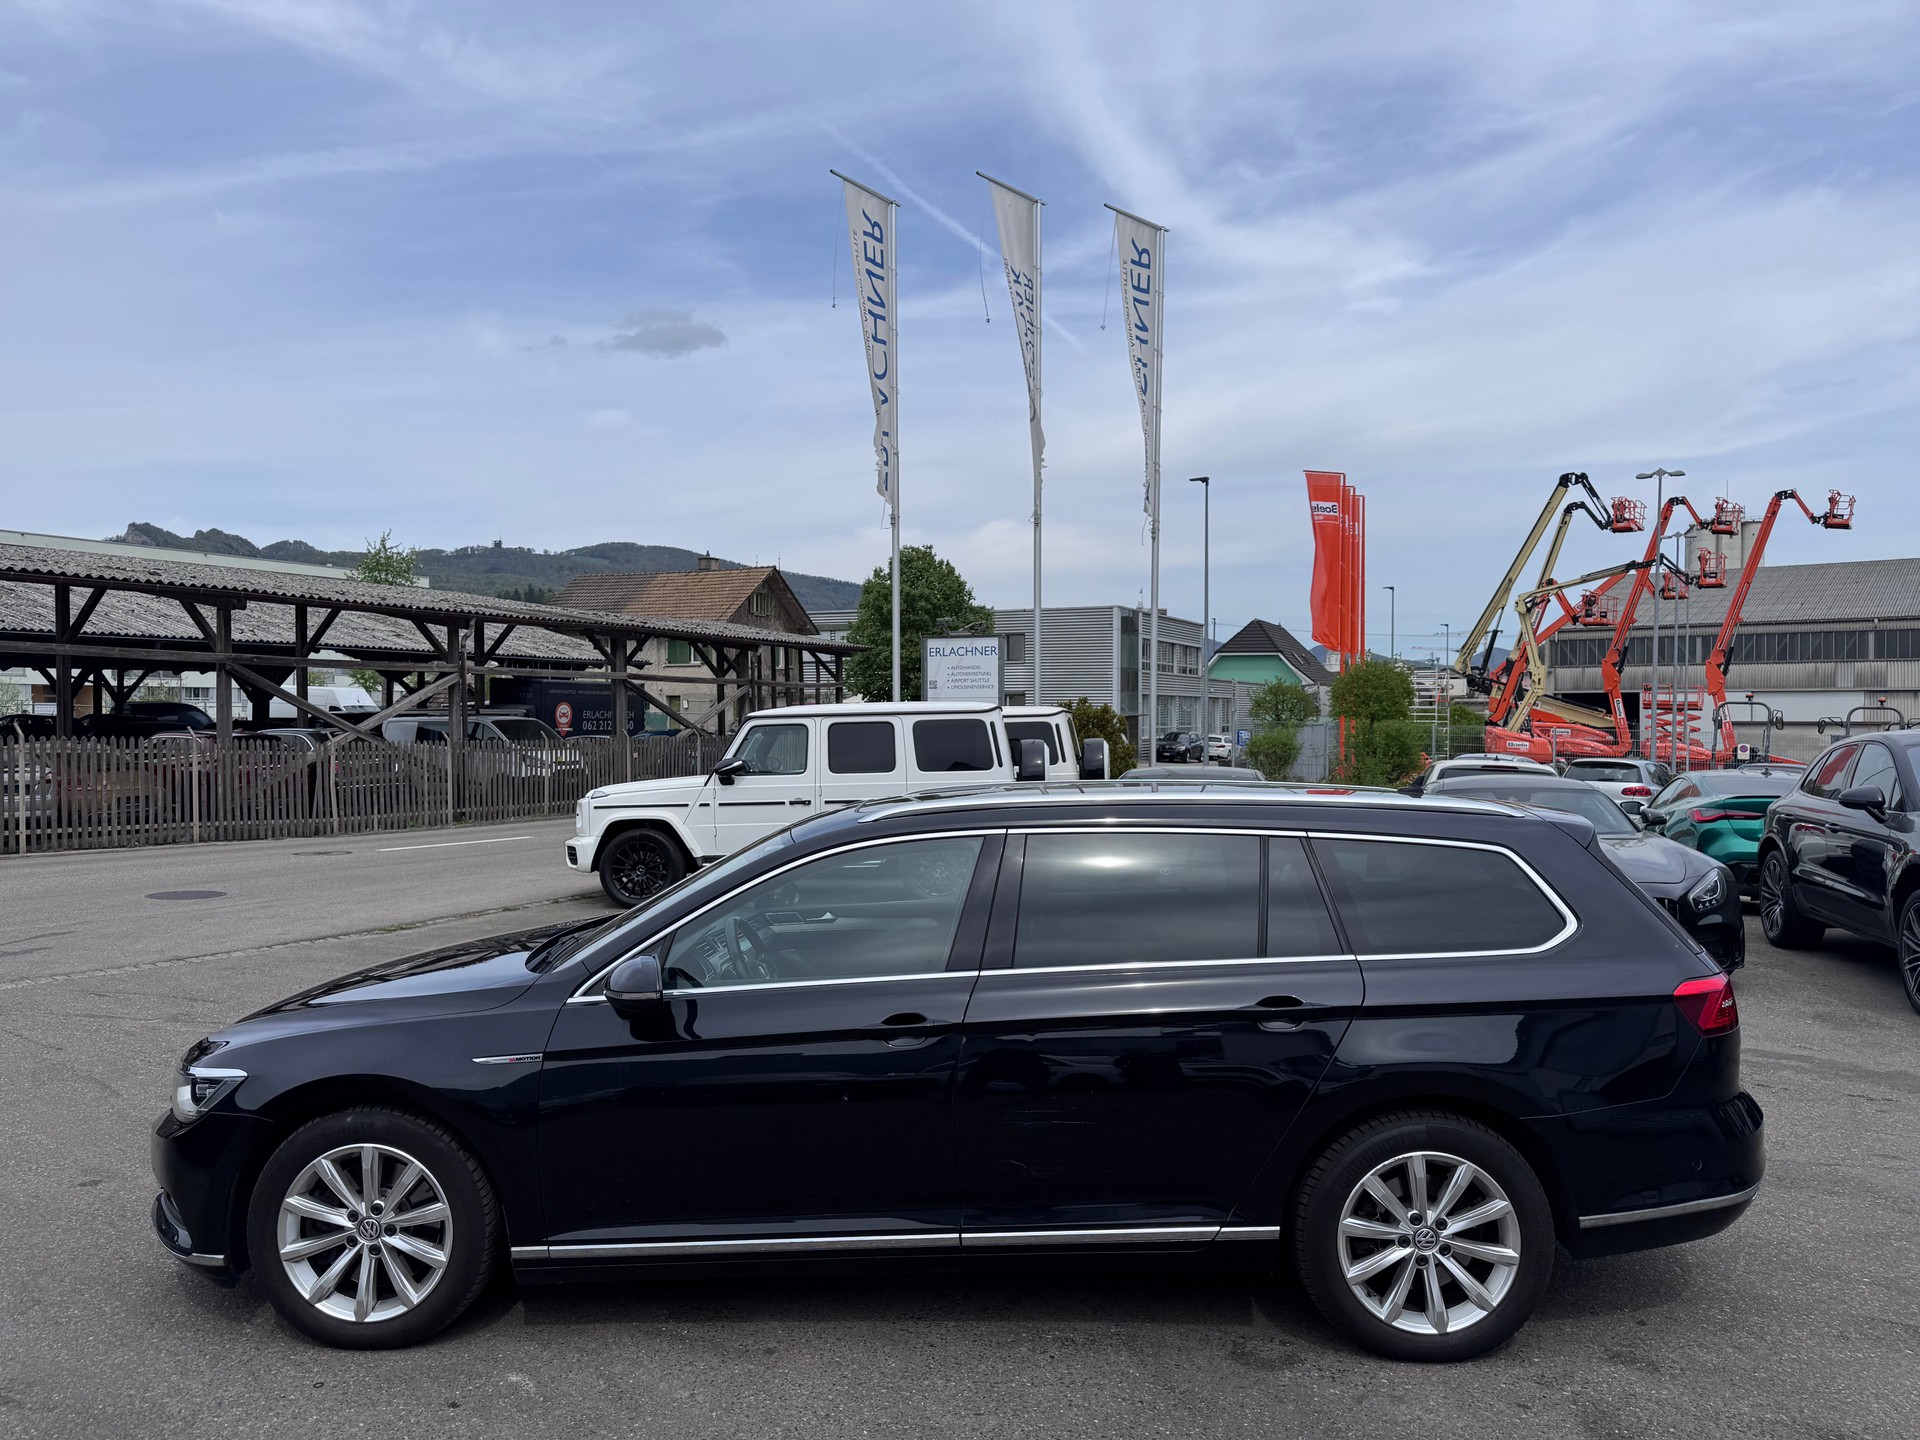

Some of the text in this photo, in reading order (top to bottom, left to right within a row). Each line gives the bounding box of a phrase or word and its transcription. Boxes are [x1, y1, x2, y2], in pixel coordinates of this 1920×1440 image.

[929, 646, 998, 657] ERLACHNER
[582, 721, 596, 730] 062
[599, 721, 612, 730] 212
